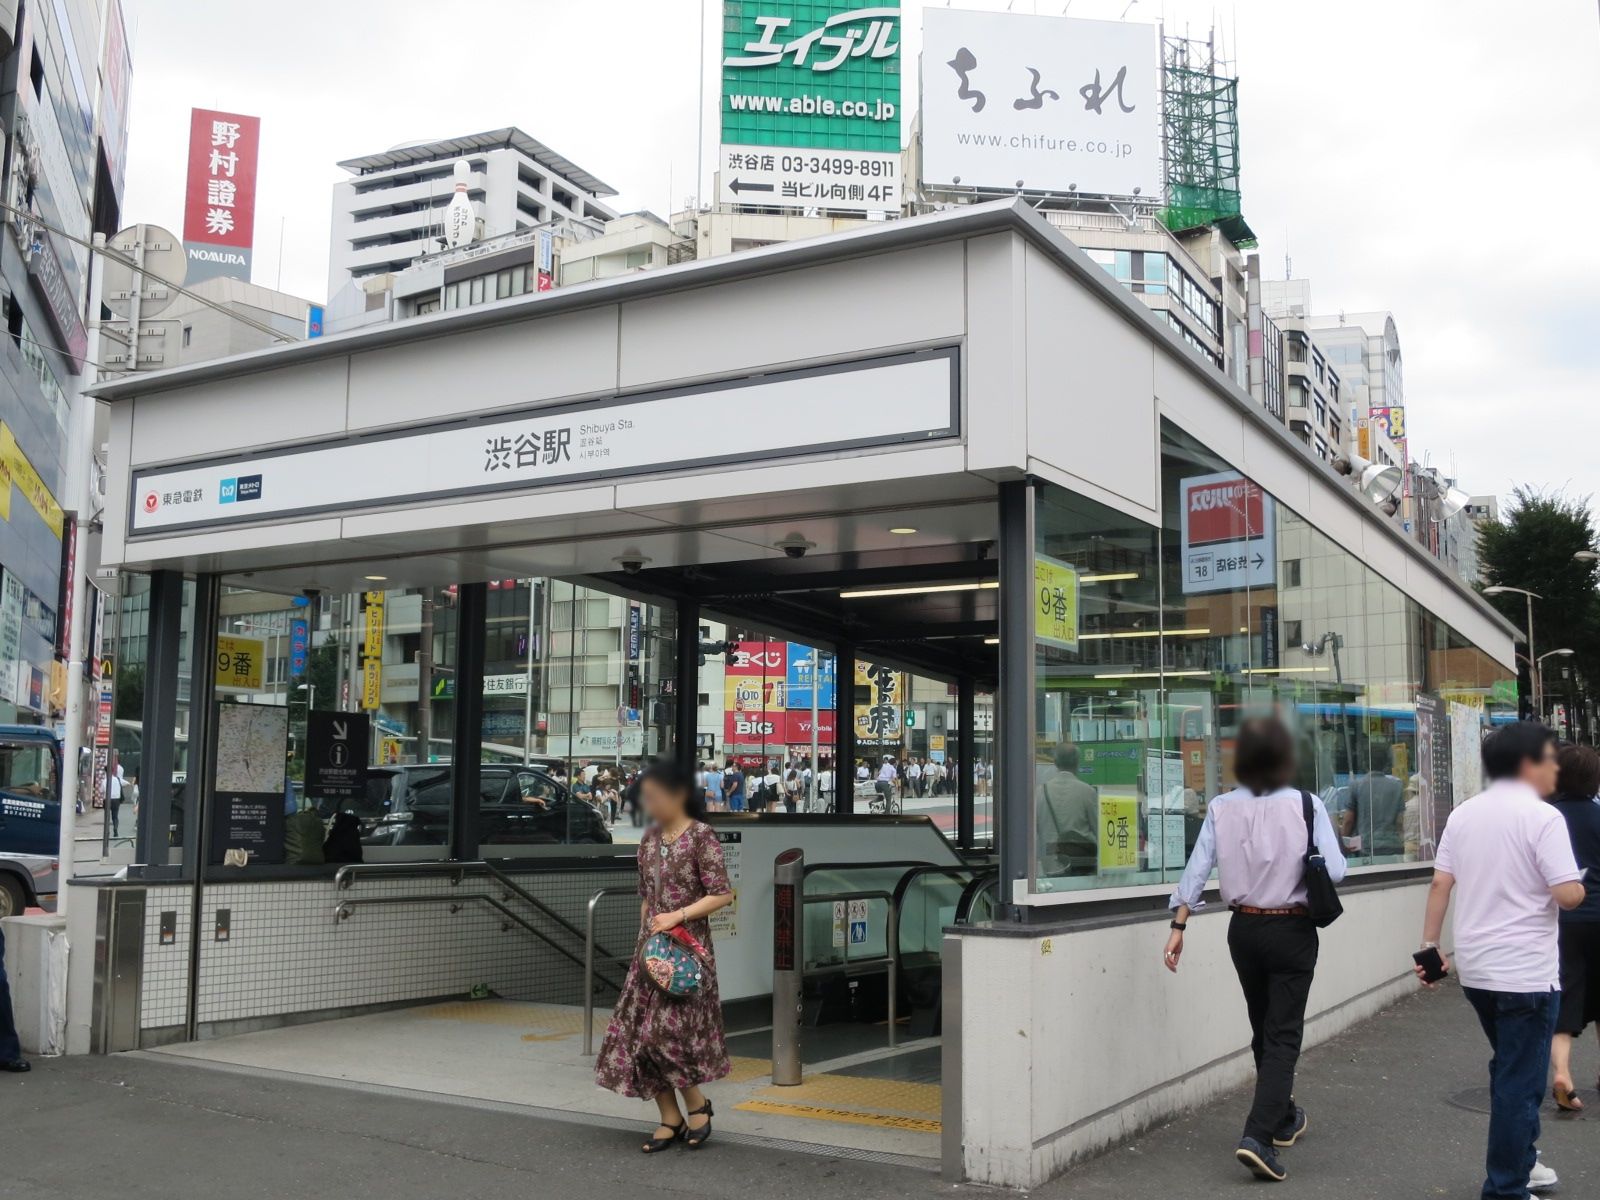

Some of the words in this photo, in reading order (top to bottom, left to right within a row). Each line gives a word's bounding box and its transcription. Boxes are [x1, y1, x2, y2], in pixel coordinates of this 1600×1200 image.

[723, 8, 900, 71] エイブル
[946, 47, 1135, 114] ちふれ
[730, 95, 895, 120] www.able.co.jp
[957, 132, 1132, 157] www.chifure.co.jp
[728, 153, 775, 171] 渋谷店
[781, 155, 894, 177] 03-3499-8911
[205, 120, 240, 236] 野村證券
[189, 248, 246, 265] NOMURA
[580, 423, 615, 435] Shibuya
[484, 428, 571, 472] 渋谷駅
[162, 488, 203, 505] 東急電鉄
[1041, 586, 1067, 623] 9番
[1053, 624, 1075, 641] 出入口
[218, 652, 252, 676] 9番
[233, 676, 260, 688] 出入口
[484, 678, 524, 691] 住友銀行
[735, 721, 775, 735] BIG
[1107, 816, 1129, 850] 9番
[1117, 851, 1135, 866] 出入口
